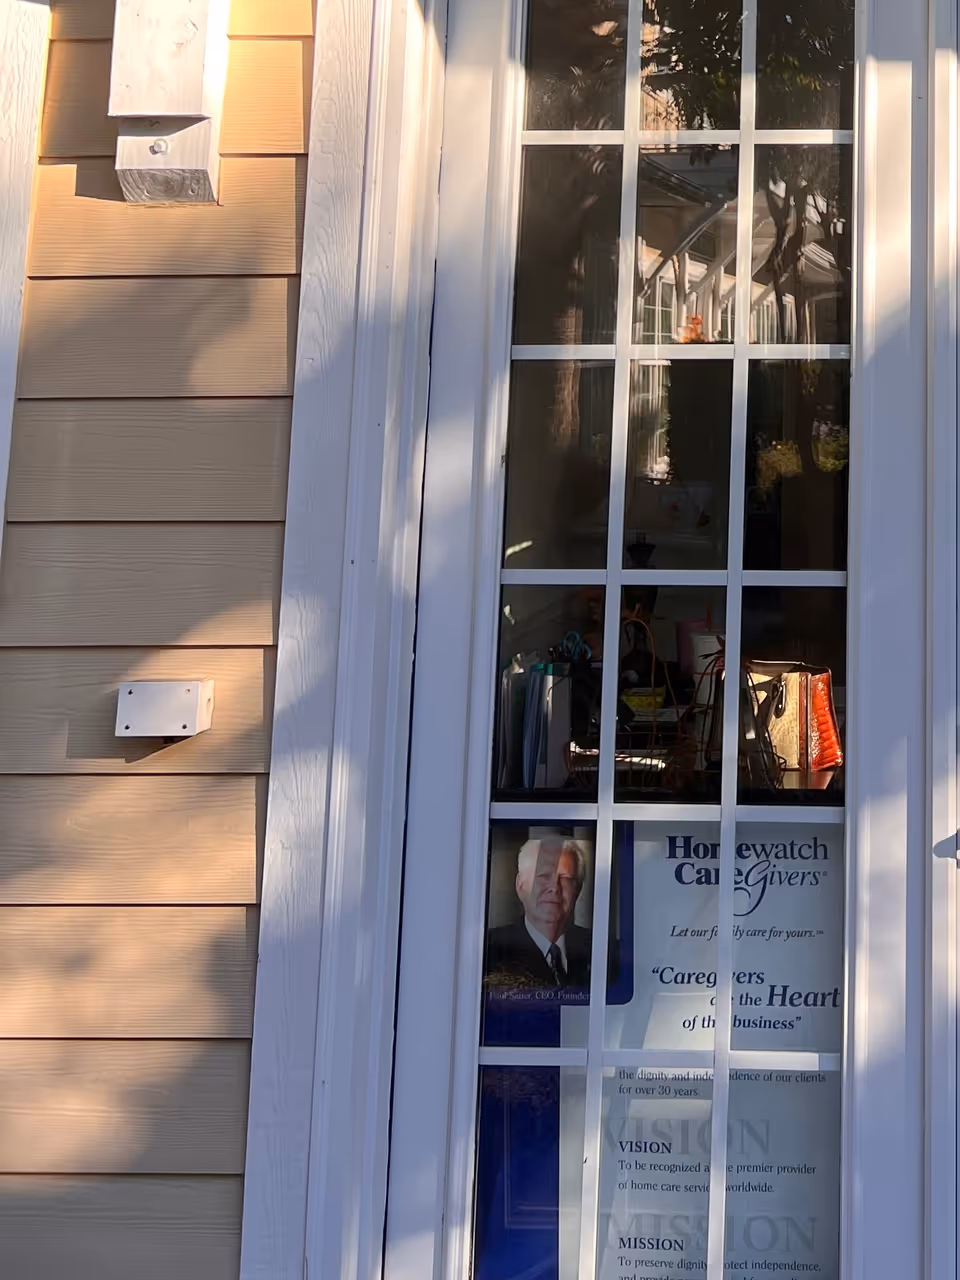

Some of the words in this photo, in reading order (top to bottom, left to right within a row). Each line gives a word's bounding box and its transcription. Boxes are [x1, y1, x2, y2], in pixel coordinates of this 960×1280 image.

[669, 924, 690, 938] Let
[689, 927, 708, 938] our
[745, 928, 768, 939] care
[766, 925, 783, 942] for
[738, 992, 763, 1007] the
[765, 983, 841, 1008] Heart
[681, 1014, 699, 1031] of
[700, 1014, 716, 1029] th
[618, 1069, 635, 1081] the
[636, 1070, 668, 1082] dignity
[670, 1070, 691, 1082] and
[762, 1070, 774, 1082] of
[774, 1073, 792, 1082] our
[794, 1072, 827, 1083] clients
[618, 1084, 632, 1095] for
[634, 1086, 656, 1096] over
[658, 1085, 671, 1096] 30
[618, 1140, 673, 1154] VISION
[617, 1160, 632, 1171] To
[634, 1160, 647, 1171] be
[649, 1161, 701, 1174] recognized
[736, 1163, 774, 1176] premier
[776, 1163, 817, 1176] provider
[618, 1180, 630, 1191] of
[631, 1180, 659, 1192] home
[660, 1182, 681, 1192] care
[683, 1181, 710, 1193] servic
[618, 1237, 685, 1252] MISSION
[617, 1256, 632, 1267] To
[634, 1258, 675, 1270] preserve
